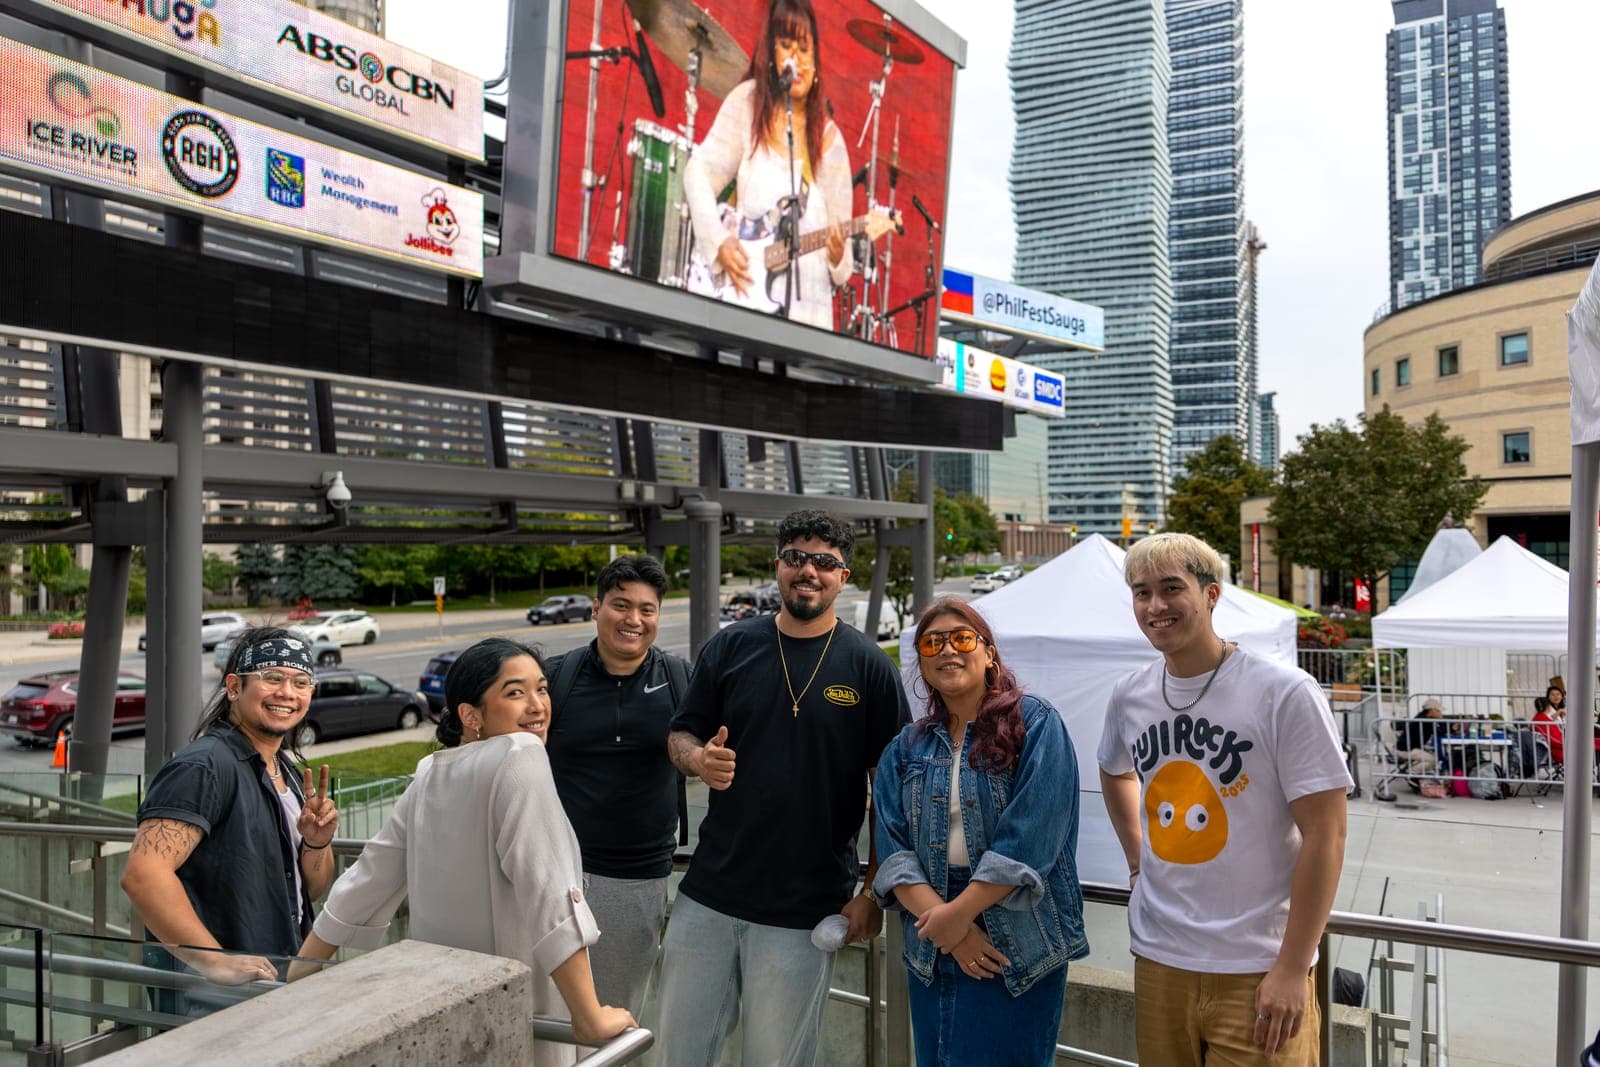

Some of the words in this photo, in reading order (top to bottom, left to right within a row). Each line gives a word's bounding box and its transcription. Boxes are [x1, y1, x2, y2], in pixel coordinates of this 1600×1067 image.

[335, 74, 410, 116] GLOBAL
[27, 119, 65, 148] ICE
[71, 132, 138, 168] RIVER
[181, 134, 223, 172] RGH
[320, 167, 365, 190] Wealth
[320, 184, 399, 216] Management
[404, 233, 453, 257] Jollibee
[983, 292, 1085, 336] @PhilFestSauga
[1035, 379, 1062, 401] SMDC
[1173, 714, 1254, 785] ROCK
[1219, 773, 1250, 798] 2025
